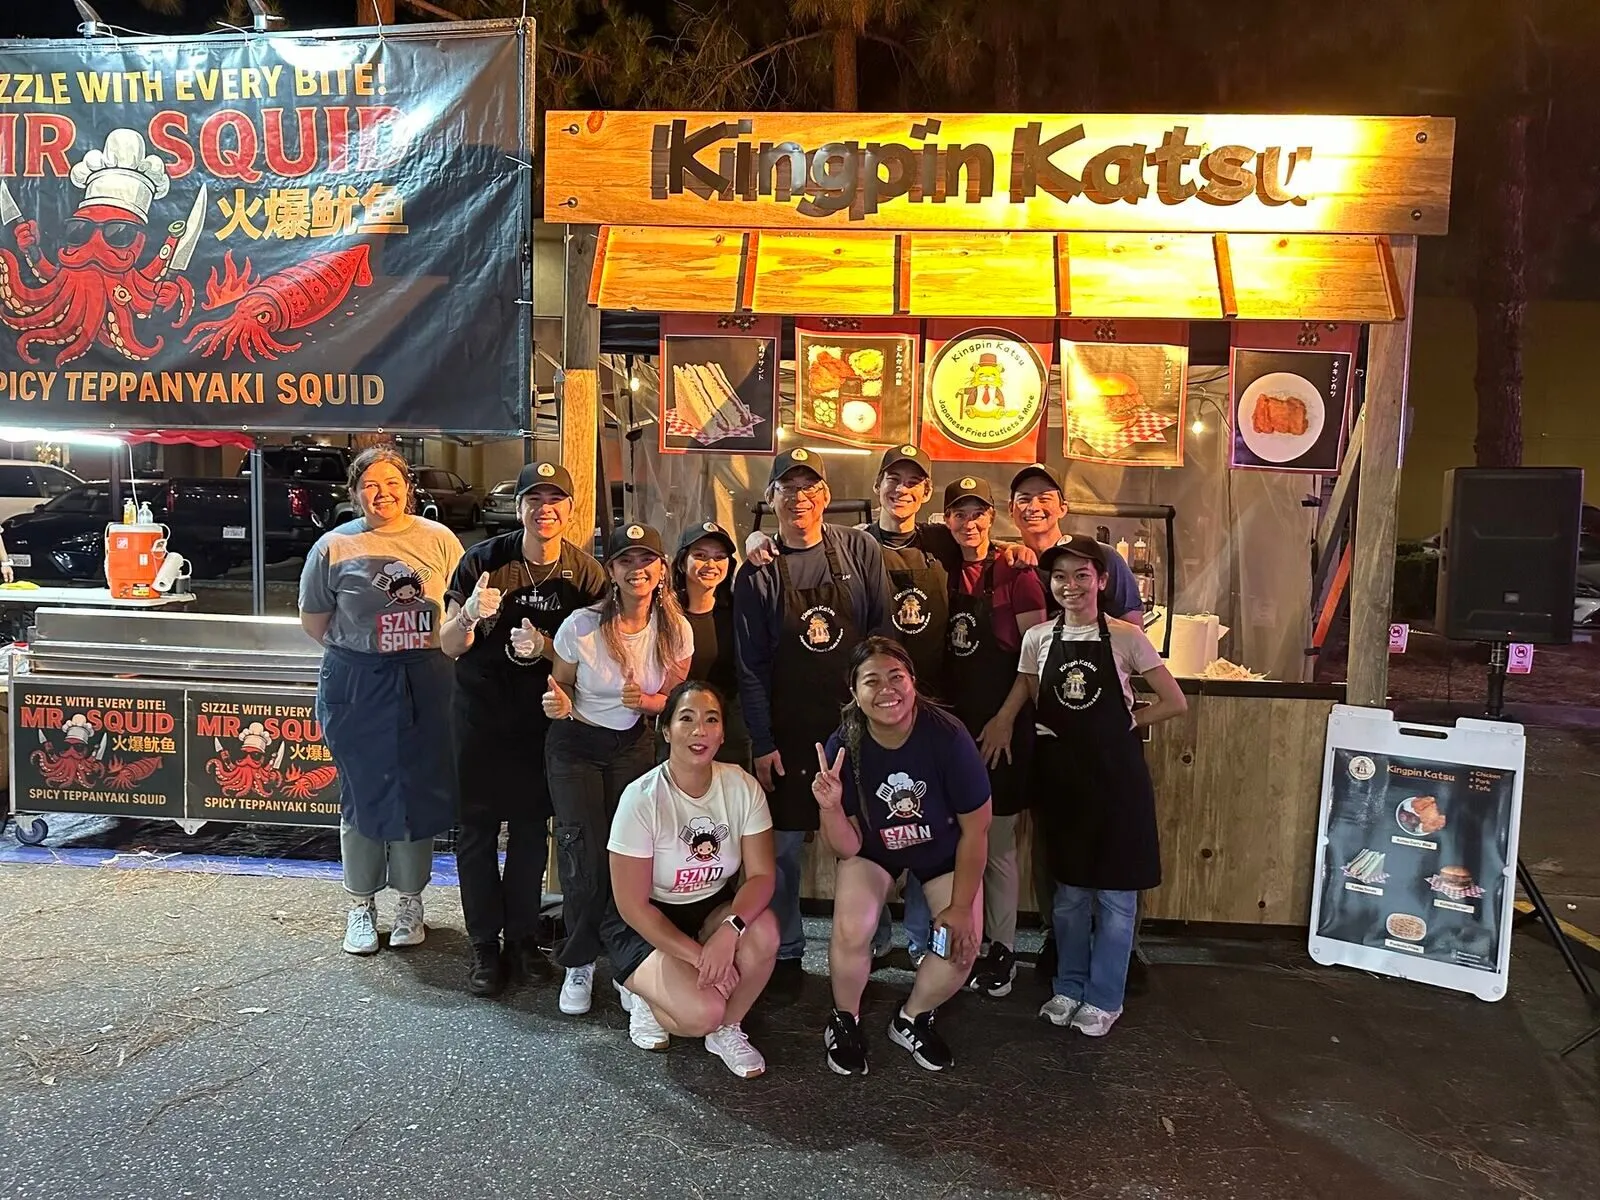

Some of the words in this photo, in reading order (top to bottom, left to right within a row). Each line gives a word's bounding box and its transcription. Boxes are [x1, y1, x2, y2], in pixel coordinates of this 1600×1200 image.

[0, 72, 71, 104] ZZLE
[76, 70, 165, 104] WITH
[176, 64, 283, 102] EVERY
[294, 62, 388, 97] BITE!
[148, 105, 409, 184] SQUID
[652, 118, 995, 221] Kingpin
[1009, 121, 1312, 207] Katsu
[214, 183, 410, 242] 火爆鱿鱼
[951, 341, 992, 363] Kingpin
[995, 341, 1025, 366] Katsu
[0, 371, 57, 401] ICY
[65, 371, 264, 405] TEPPANYAKI
[278, 373, 385, 407] SQUID
[1329, 360, 1339, 398] チキンカツ
[939, 399, 965, 432] Japanese
[965, 427, 987, 438] Fried
[988, 419, 1019, 438] Cutlets
[1023, 394, 1035, 416] More
[24, 694, 62, 706] SIZZLE
[64, 696, 94, 708] WITH
[98, 697, 133, 709] EVERY
[137, 699, 166, 711] BITE!
[201, 702, 239, 715] SIZZLE
[242, 704, 272, 716] WITH
[275, 705, 313, 718] EVERY
[20, 706, 64, 730] MR
[86, 709, 175, 735] SQUID
[196, 714, 241, 738] MR
[264, 717, 323, 742] SQU
[112, 735, 177, 754] 火爆鱿鱼
[289, 743, 333, 761] 火爆
[1386, 764, 1422, 777] Kingpin
[1423, 769, 1456, 782] Katsu
[29, 788, 60, 800] SPICY
[62, 789, 129, 804] TEPPANYAKI
[132, 793, 167, 806] SQUID
[204, 796, 237, 808] SPICY
[239, 798, 307, 813] TEPPANYAKI
